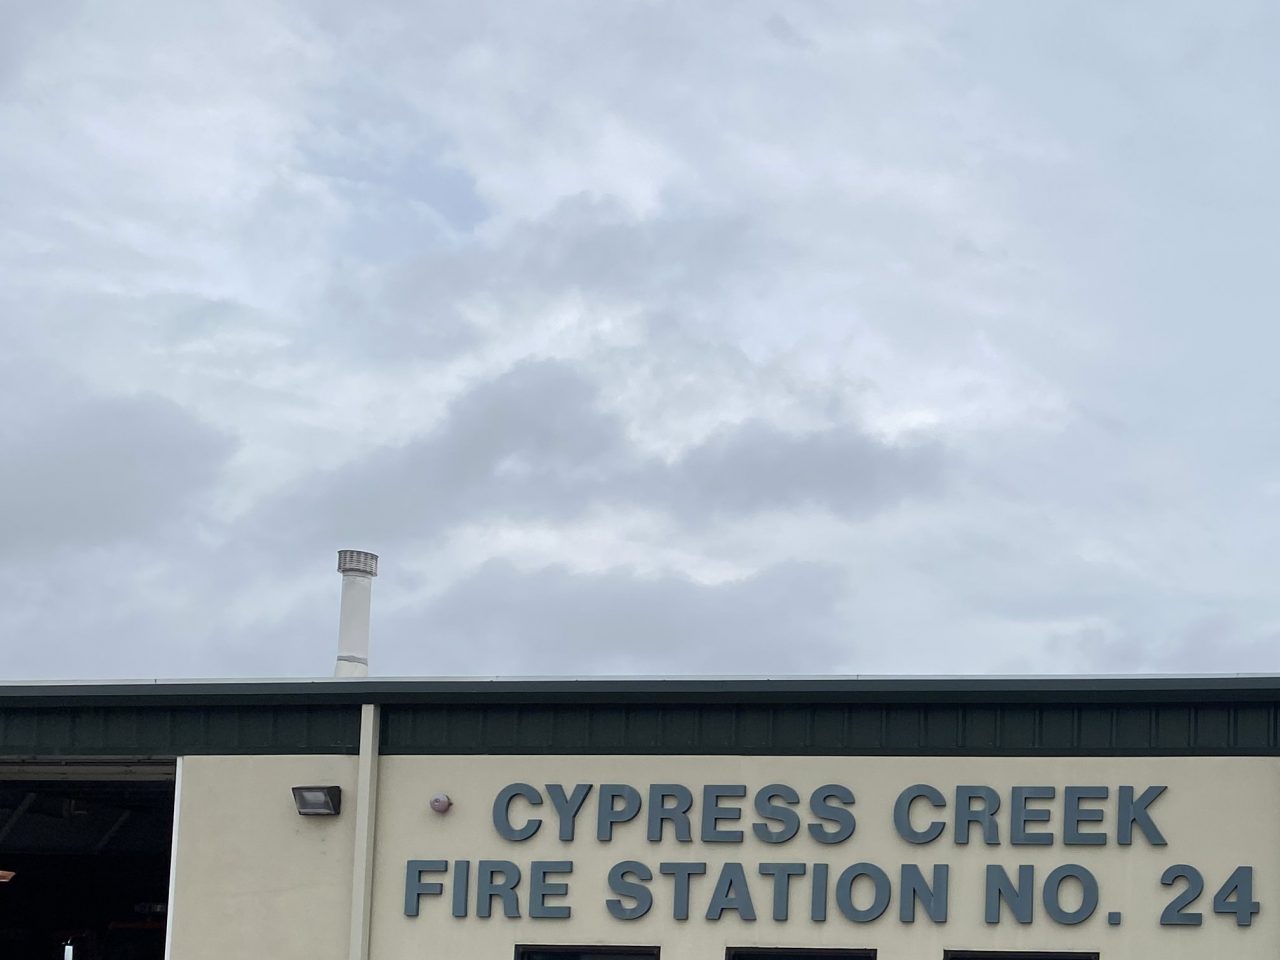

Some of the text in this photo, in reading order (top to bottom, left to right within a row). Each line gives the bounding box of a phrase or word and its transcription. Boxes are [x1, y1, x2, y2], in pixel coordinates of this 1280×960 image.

[492, 782, 1168, 846] CYPRESS CREEK
[404, 859, 1260, 927] FIRE STATION NO. 24
